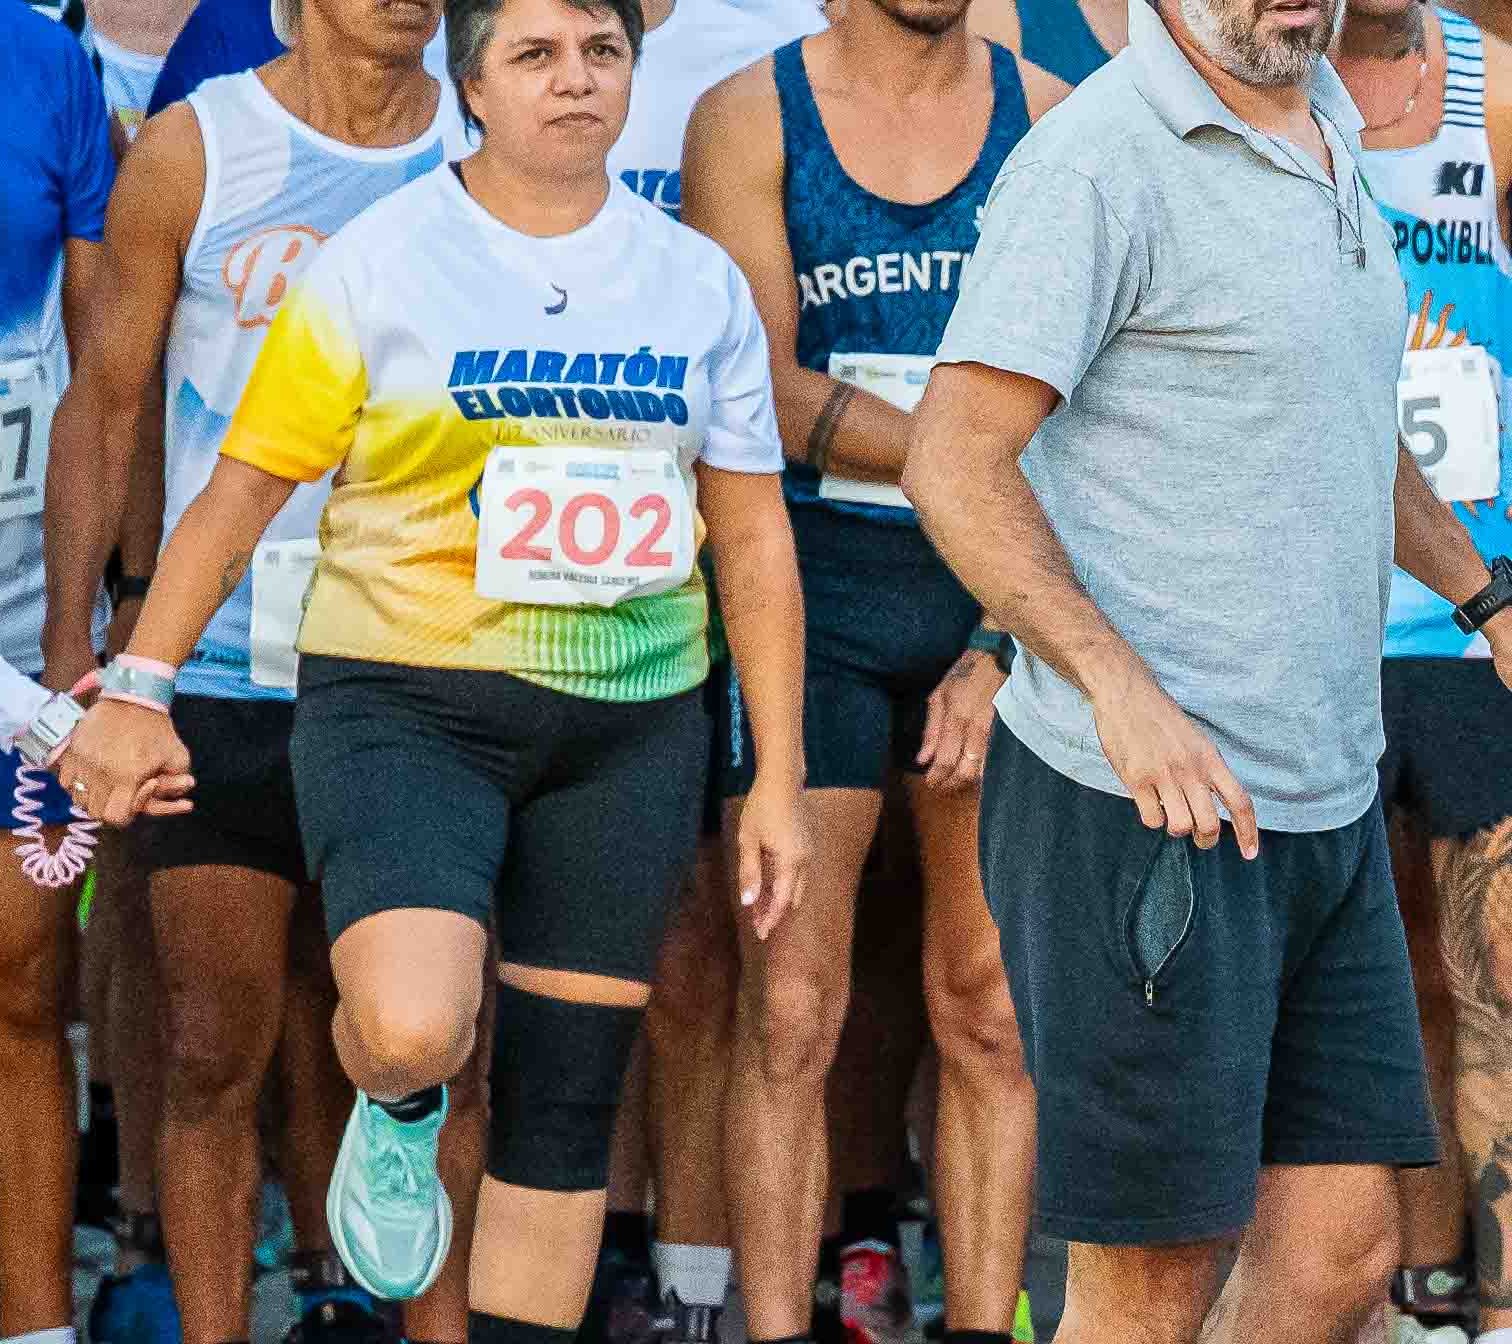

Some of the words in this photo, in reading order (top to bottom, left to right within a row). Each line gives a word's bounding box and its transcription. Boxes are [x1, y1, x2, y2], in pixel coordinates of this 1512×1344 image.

[1395, 220, 1495, 265] POSIBL
[448, 346, 689, 390] MARATÓN
[450, 386, 689, 426] ELORTONDO
[500, 487, 674, 567] 202
